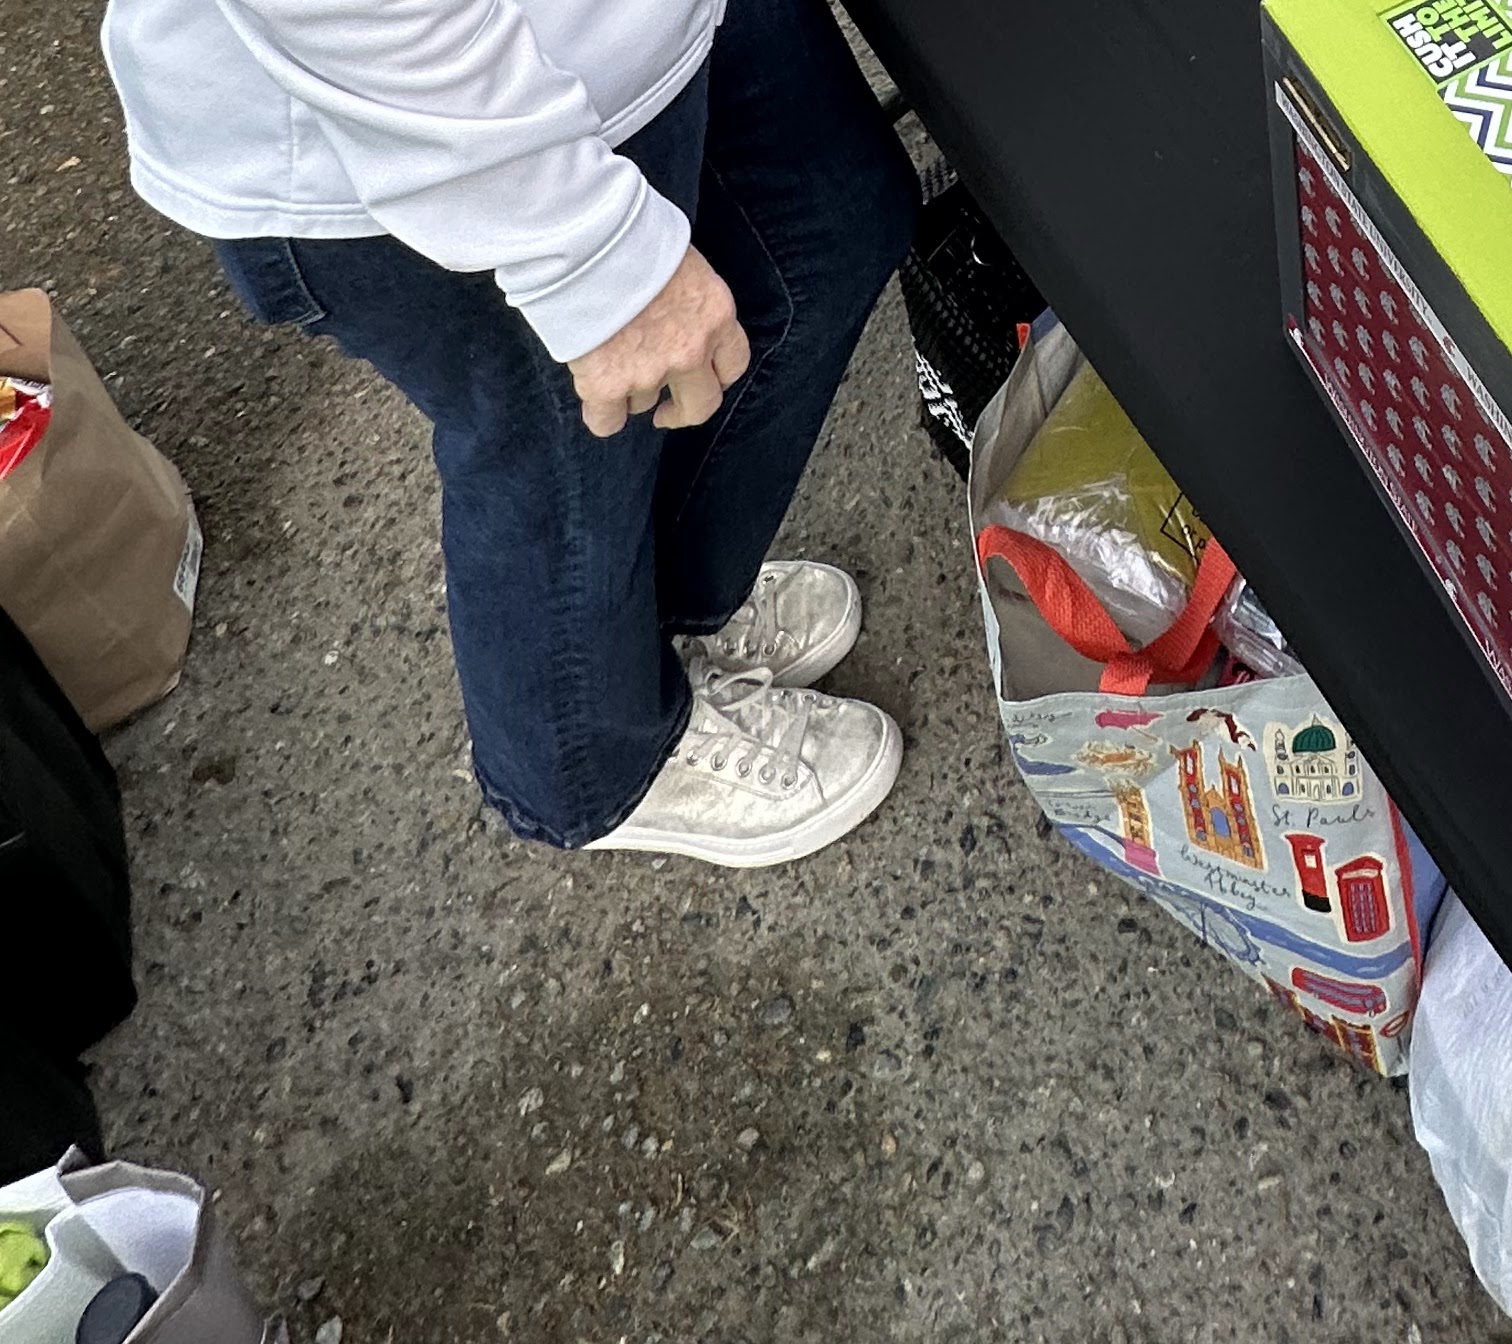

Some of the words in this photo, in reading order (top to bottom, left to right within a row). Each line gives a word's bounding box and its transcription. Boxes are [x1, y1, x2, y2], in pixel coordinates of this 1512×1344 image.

[1415, 6, 1455, 42] TO
[1392, 13, 1454, 79] CUSH
[1440, 41, 1477, 71] IT
